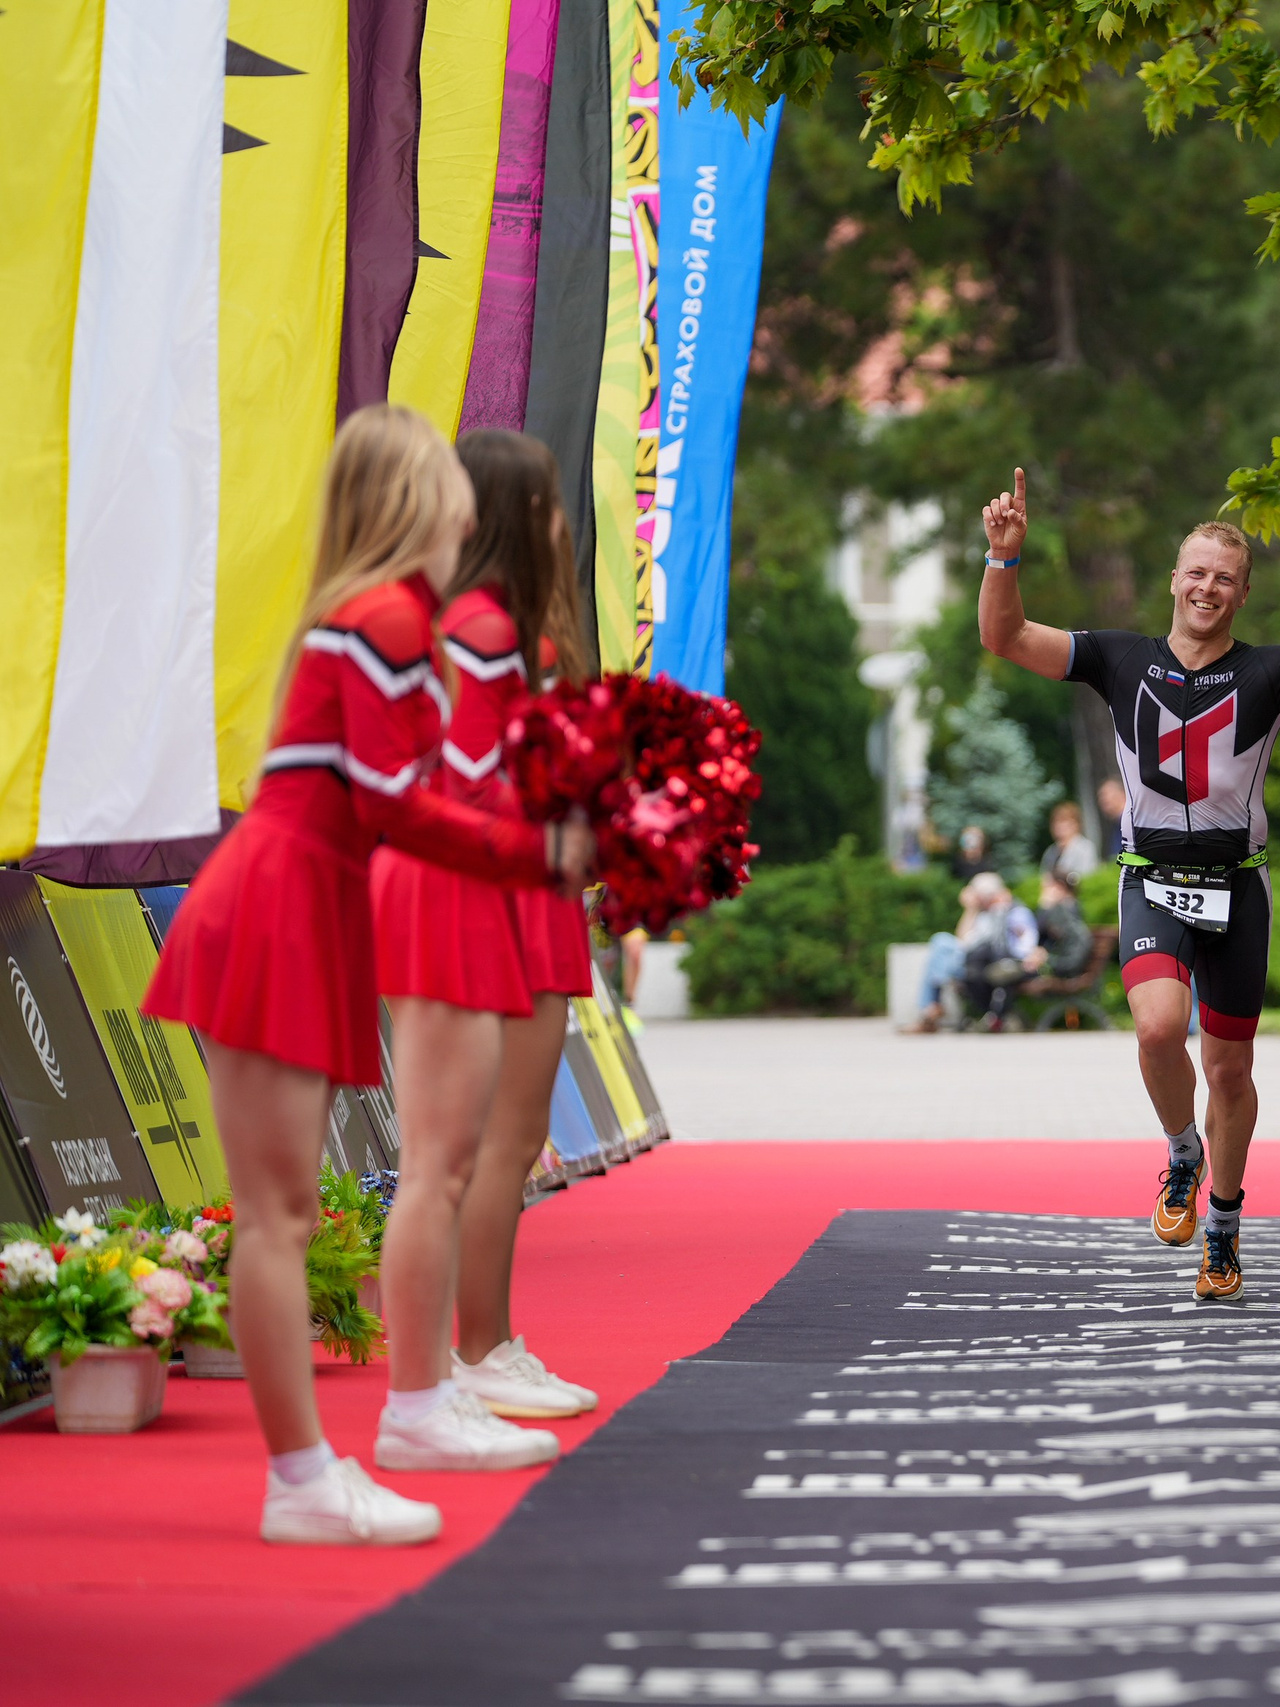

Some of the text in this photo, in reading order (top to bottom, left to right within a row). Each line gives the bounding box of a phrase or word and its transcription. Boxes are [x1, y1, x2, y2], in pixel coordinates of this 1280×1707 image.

[666, 246, 711, 435] СТРАХОВОЙ
[689, 164, 719, 243] ДОМ
[1194, 670, 1235, 687] LYATSKIY
[1165, 890, 1205, 915] 332
[102, 1008, 161, 1106] IRON
[51, 1137, 122, 1187] ГАЗПРОМБАНК
[922, 1264, 1132, 1276] IRON
[798, 1402, 1094, 1423] IRON
[748, 1472, 1083, 1496] IRON
[672, 1557, 1065, 1586] IRON
[568, 1662, 1037, 1702] IRON
